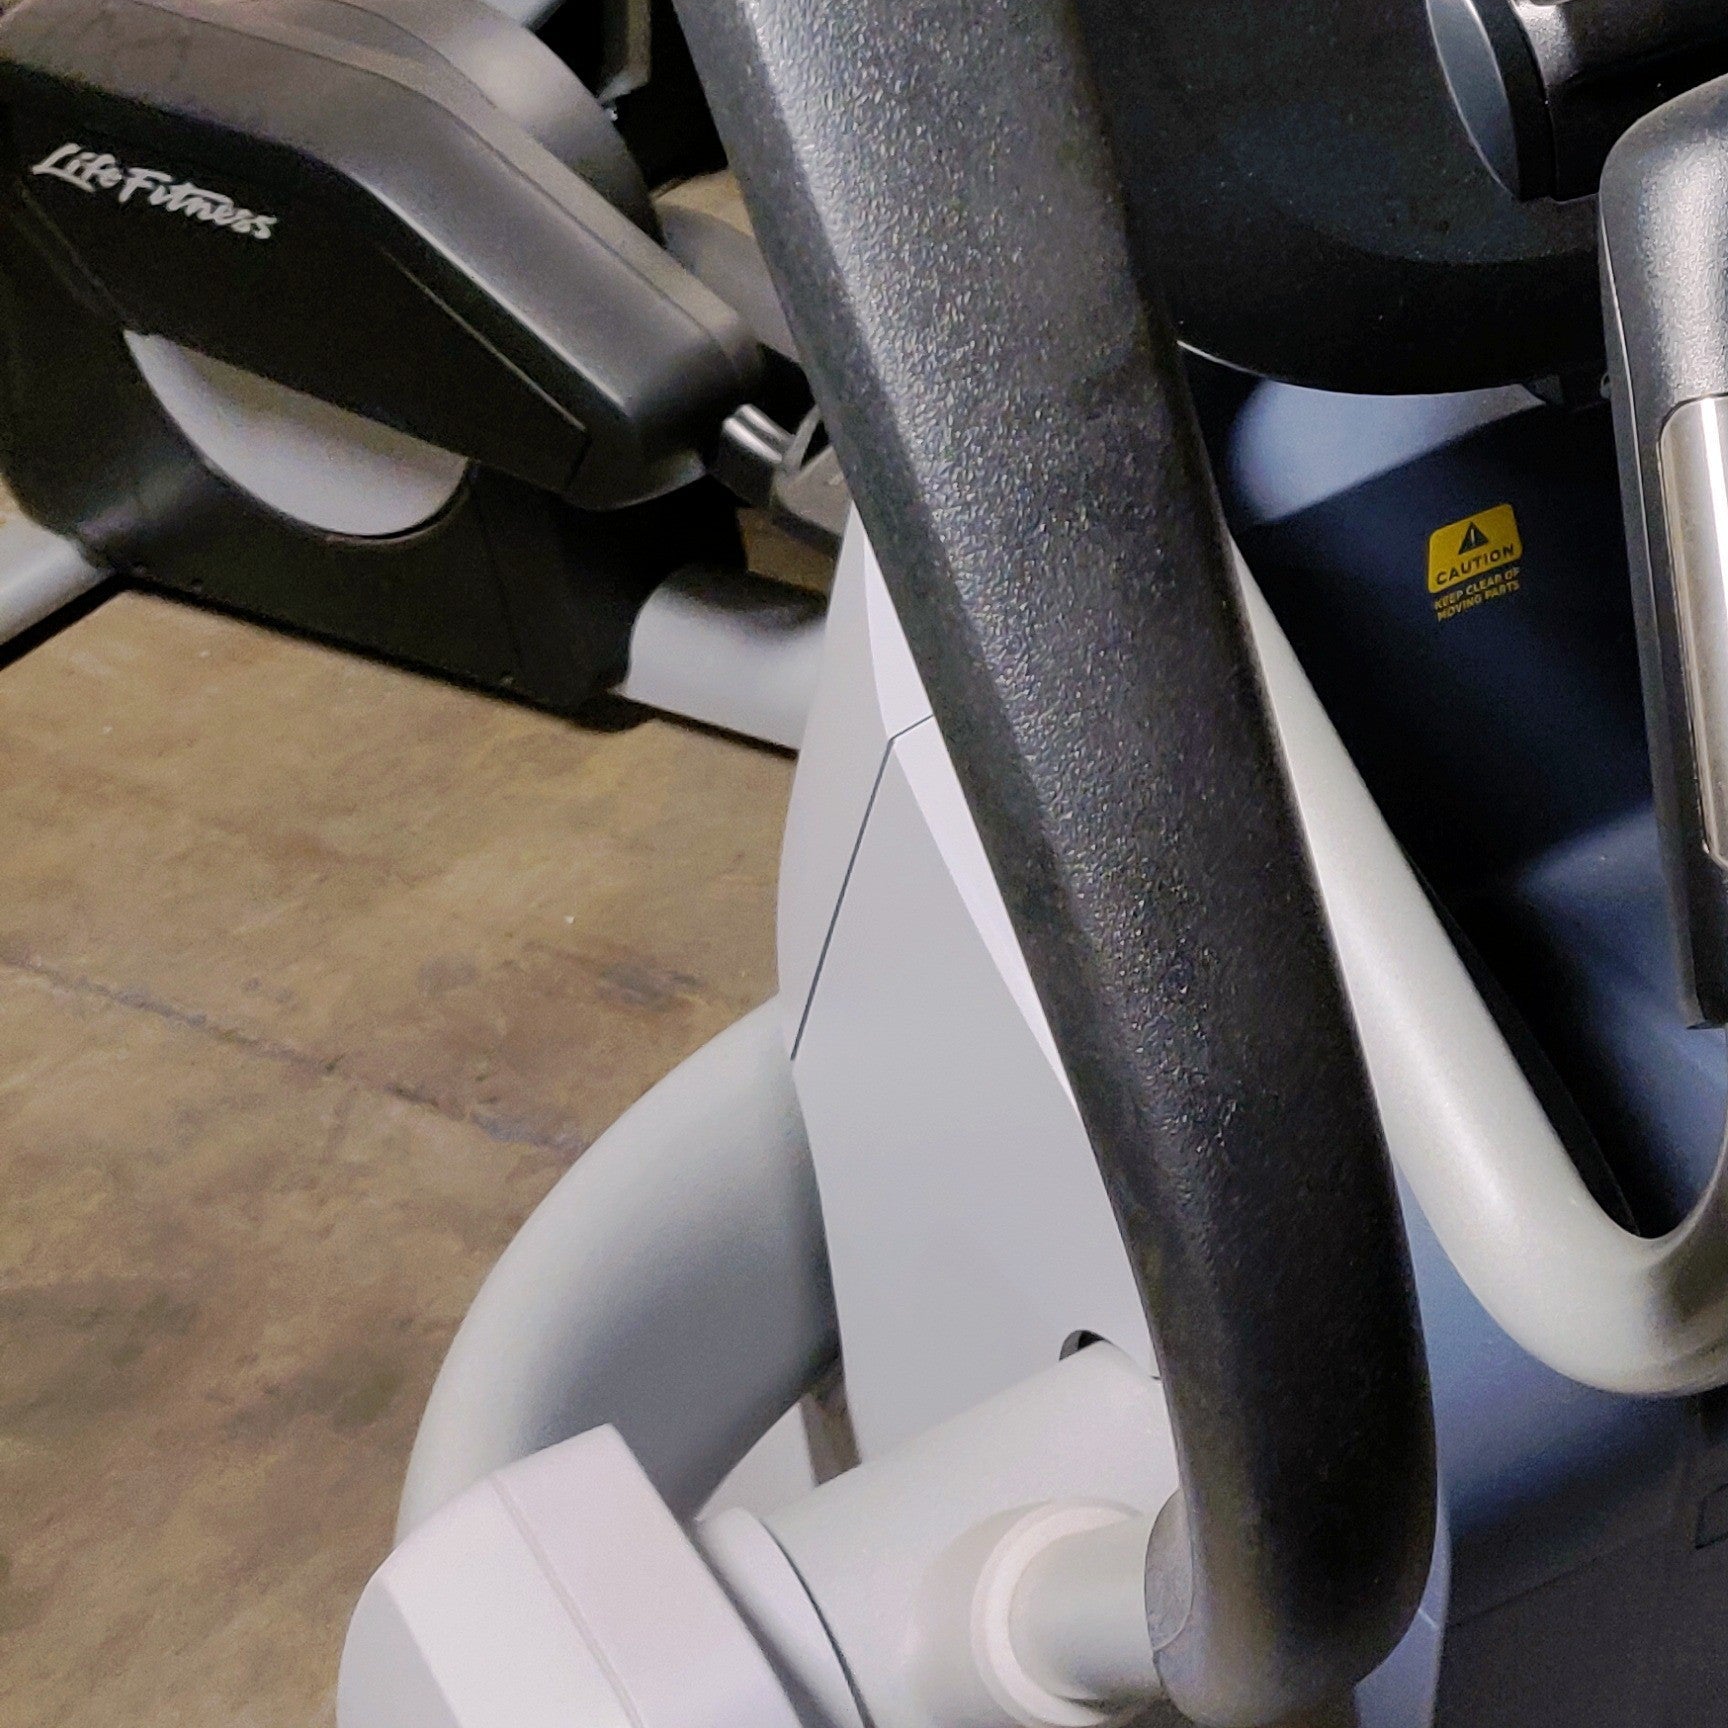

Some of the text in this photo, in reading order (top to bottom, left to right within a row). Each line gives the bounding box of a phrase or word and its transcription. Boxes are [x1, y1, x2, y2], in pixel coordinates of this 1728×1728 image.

[1436, 544, 1514, 585] CAUTION
[1434, 567, 1521, 610] KEEP CLEAR OF
[1437, 580, 1520, 621] MOVING PARTS
